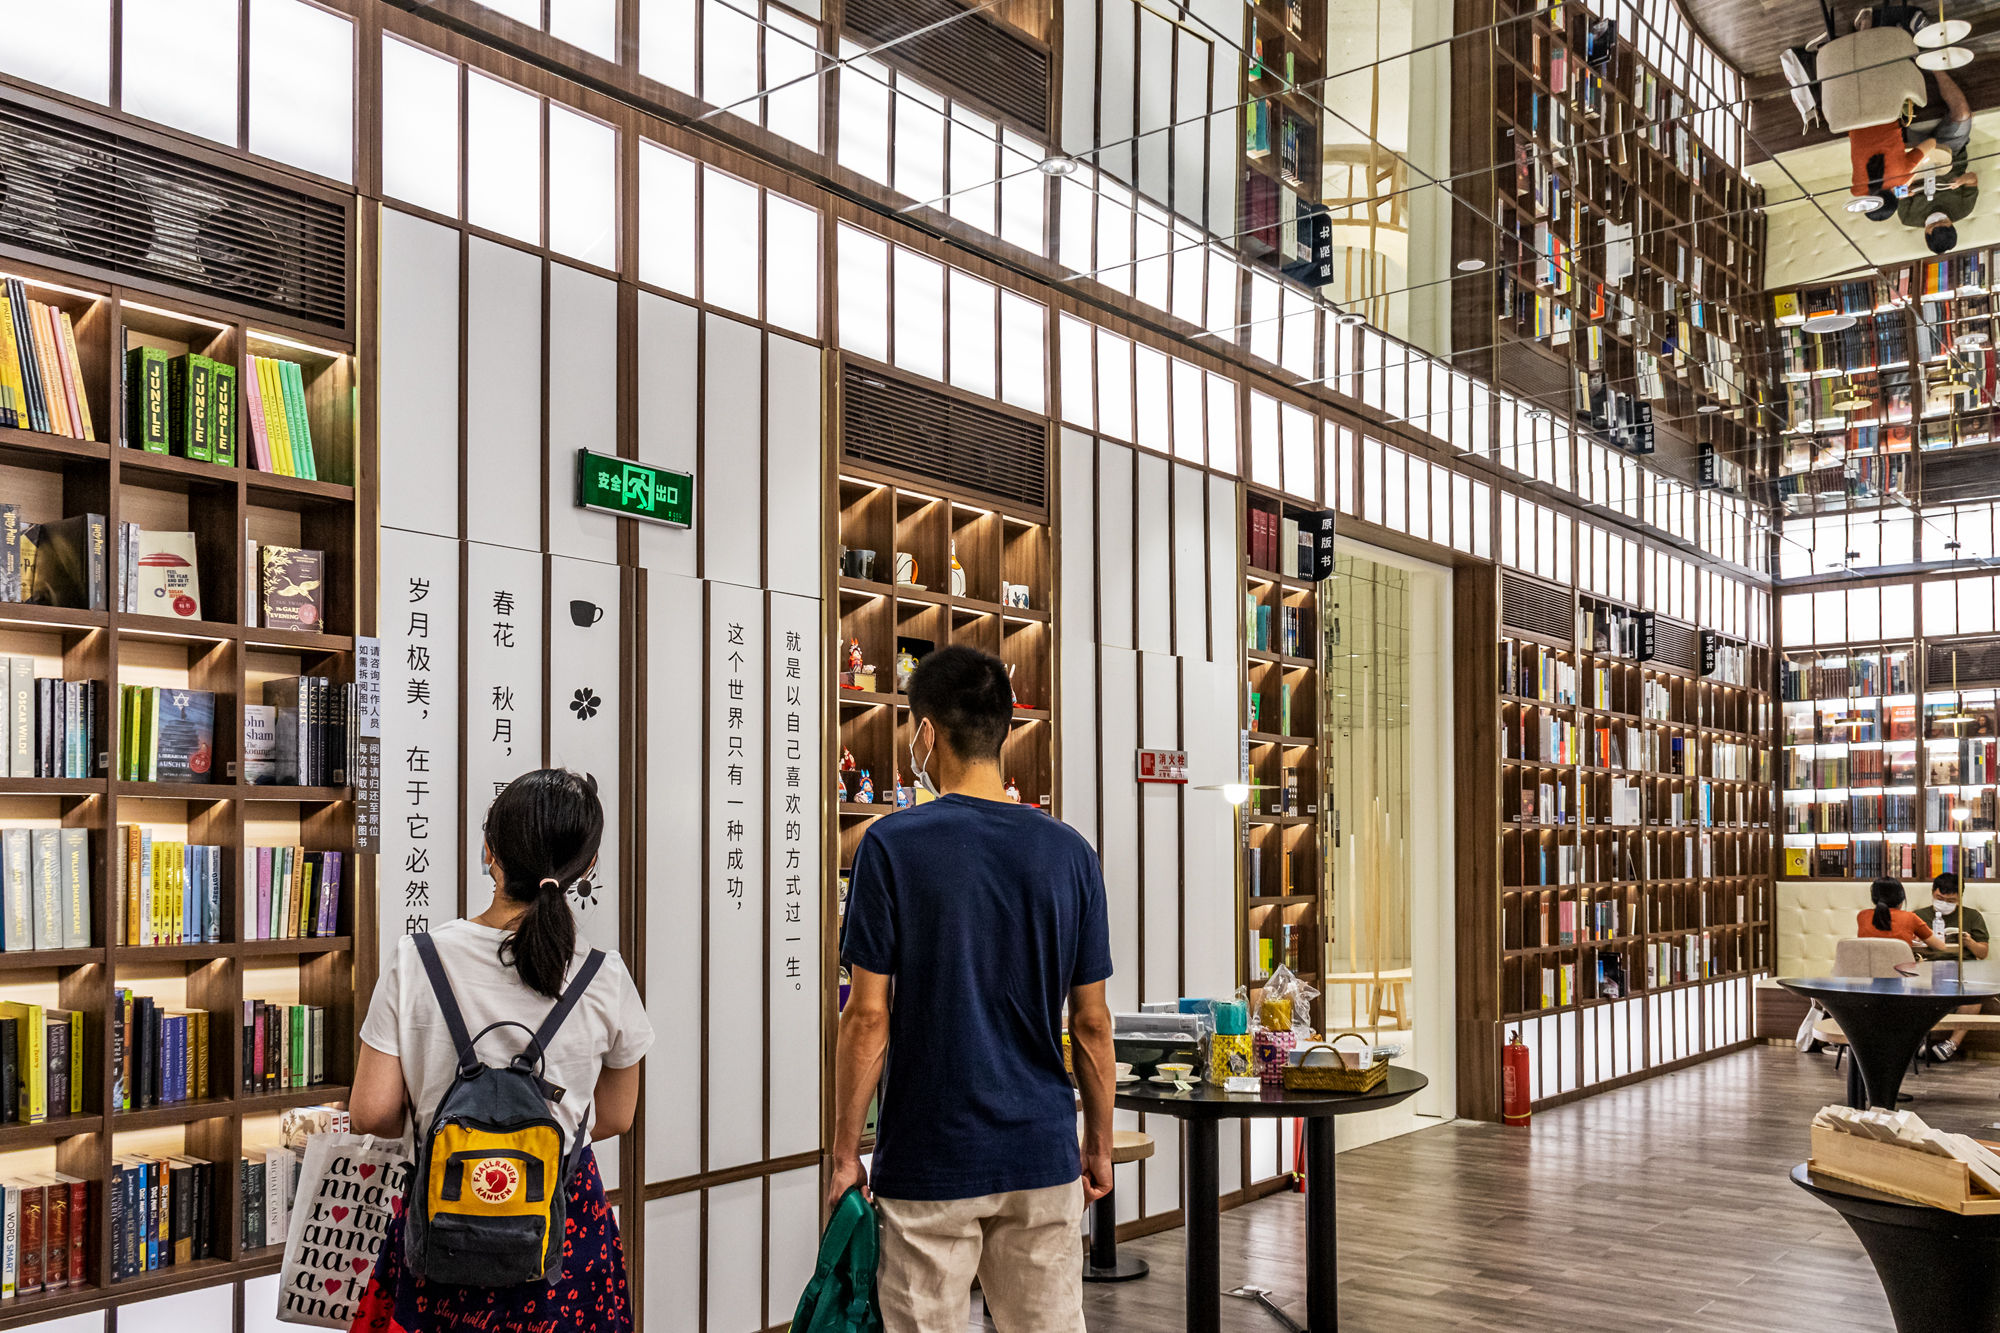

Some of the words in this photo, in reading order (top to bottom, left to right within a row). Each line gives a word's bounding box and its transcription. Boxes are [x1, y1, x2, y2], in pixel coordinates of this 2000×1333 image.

[150, 365, 161, 437] JUNGLE
[195, 372, 205, 443] JUNGLE
[219, 380, 228, 450] JUNGLE
[598, 471, 622, 492] 安全
[656, 484, 678, 505] 出口
[1320, 518, 1333, 567] 原版书
[493, 590, 515, 648] 春花
[1705, 636, 1714, 669] 艺术设计
[359, 645, 368, 716] 如需拆阅图书
[370, 646, 380, 729] 请咨询工作人员
[18, 691, 27, 722] OSCAR
[244, 716, 264, 727] ohn
[18, 724, 27, 755] WILDE
[246, 729, 273, 741] sham
[727, 622, 744, 910] 这个世界只有一种成功，
[1158, 753, 1185, 766] 消火栓
[358, 743, 368, 847] 每次请取阅一本图书
[369, 743, 380, 837] 阅毕请归还至原位
[785, 630, 802, 991] 就是以自己喜欢的方式过一生。
[130, 830, 138, 860] RADICAL
[142, 837, 150, 876] TRAILBLAZER
[72, 884, 81, 934] SHAKESPEARE
[51, 1026, 59, 1057] MARTIN
[150, 1186, 158, 1198] DOG
[317, 1178, 389, 1208] nna
[7, 1212, 15, 1241] WORD
[6, 1244, 14, 1274] SMART
[127, 1233, 135, 1264] MONSTER
[296, 1245, 351, 1273] na
[462, 1310, 495, 1330] wild
